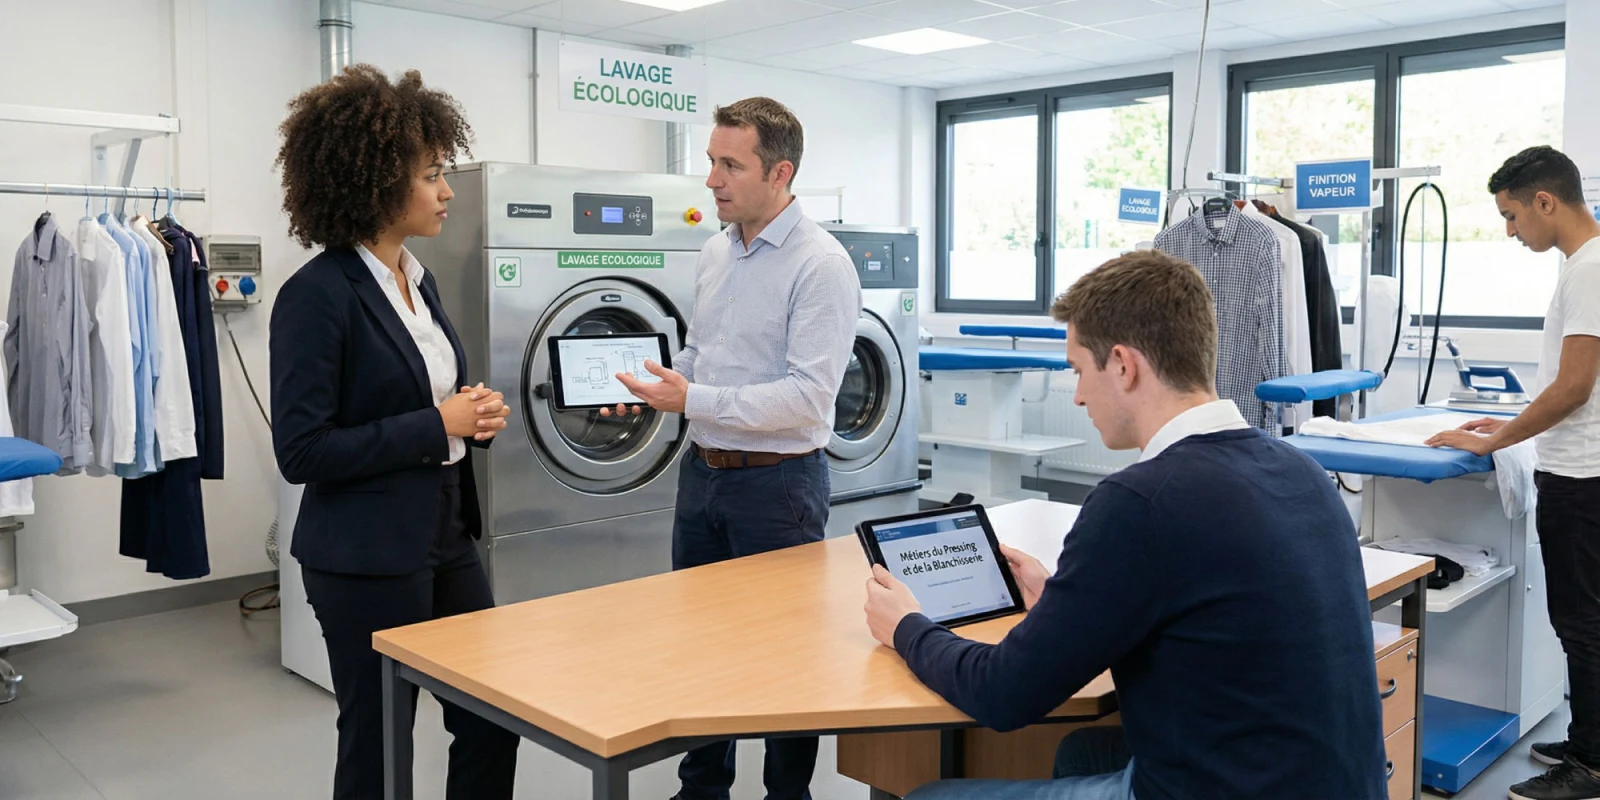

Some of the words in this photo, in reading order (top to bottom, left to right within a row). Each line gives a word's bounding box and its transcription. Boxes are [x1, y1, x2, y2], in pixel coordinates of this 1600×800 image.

[600, 58, 672, 84] LAVAGE
[573, 76, 697, 113] ÉCOLOGIQUE
[1308, 172, 1356, 186] FINITION
[1309, 186, 1356, 198] VAPEUR
[561, 254, 599, 265] LAVAGE
[601, 254, 661, 266] ECOLOGIQUE
[899, 549, 932, 562] Métiers
[932, 546, 943, 557] du
[943, 541, 978, 555] Pressing
[902, 565, 913, 576] et
[913, 563, 924, 574] de
[923, 561, 932, 572] la
[932, 552, 984, 571] Blanchisserie
